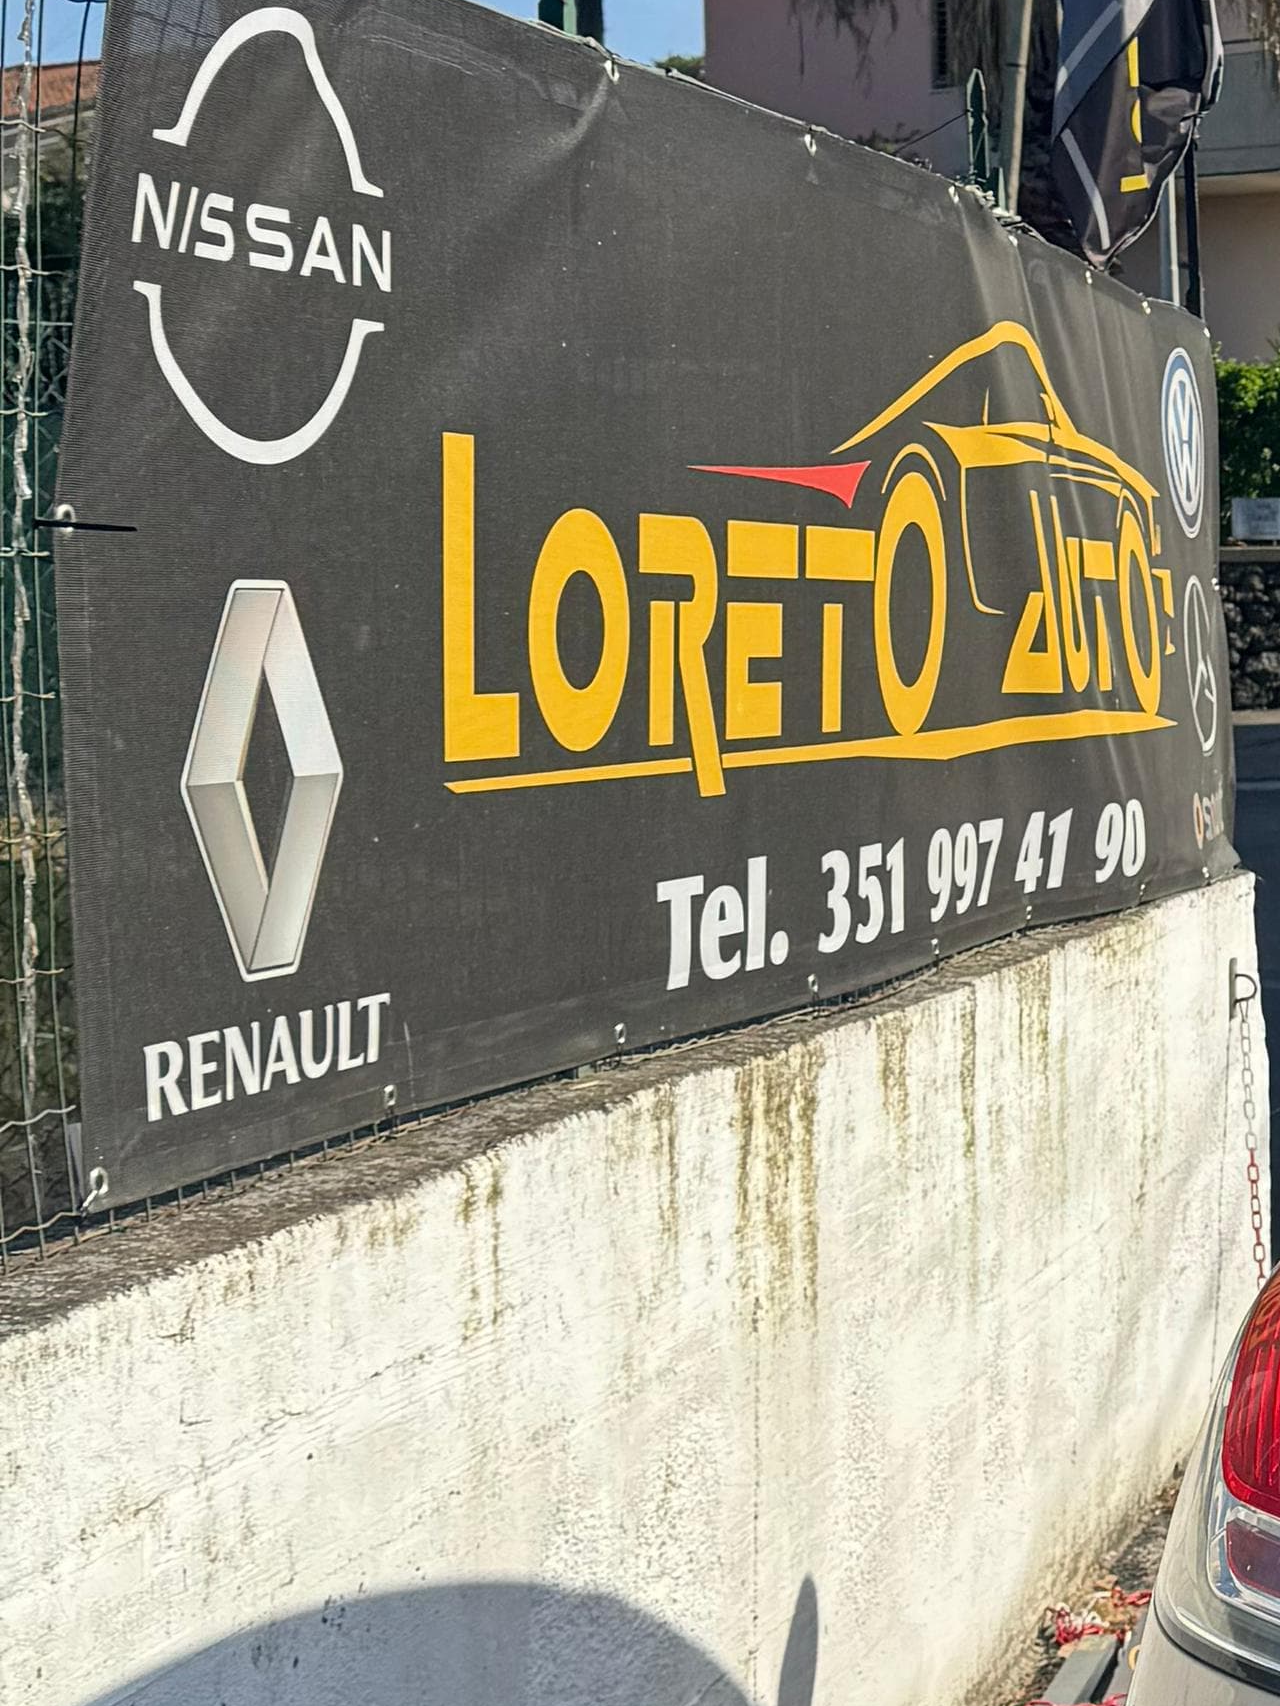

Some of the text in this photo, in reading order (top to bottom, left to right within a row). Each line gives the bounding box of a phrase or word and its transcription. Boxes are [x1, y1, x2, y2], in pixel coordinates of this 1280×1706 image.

[131, 172, 392, 292] NISSAN
[442, 431, 1162, 797] LORETO AUTO
[656, 855, 790, 991] Tel.
[818, 837, 904, 953] 351
[927, 818, 1004, 923] 997
[1014, 808, 1074, 893] 41
[1095, 799, 1146, 884] 90
[143, 992, 391, 1122] RENAULT
